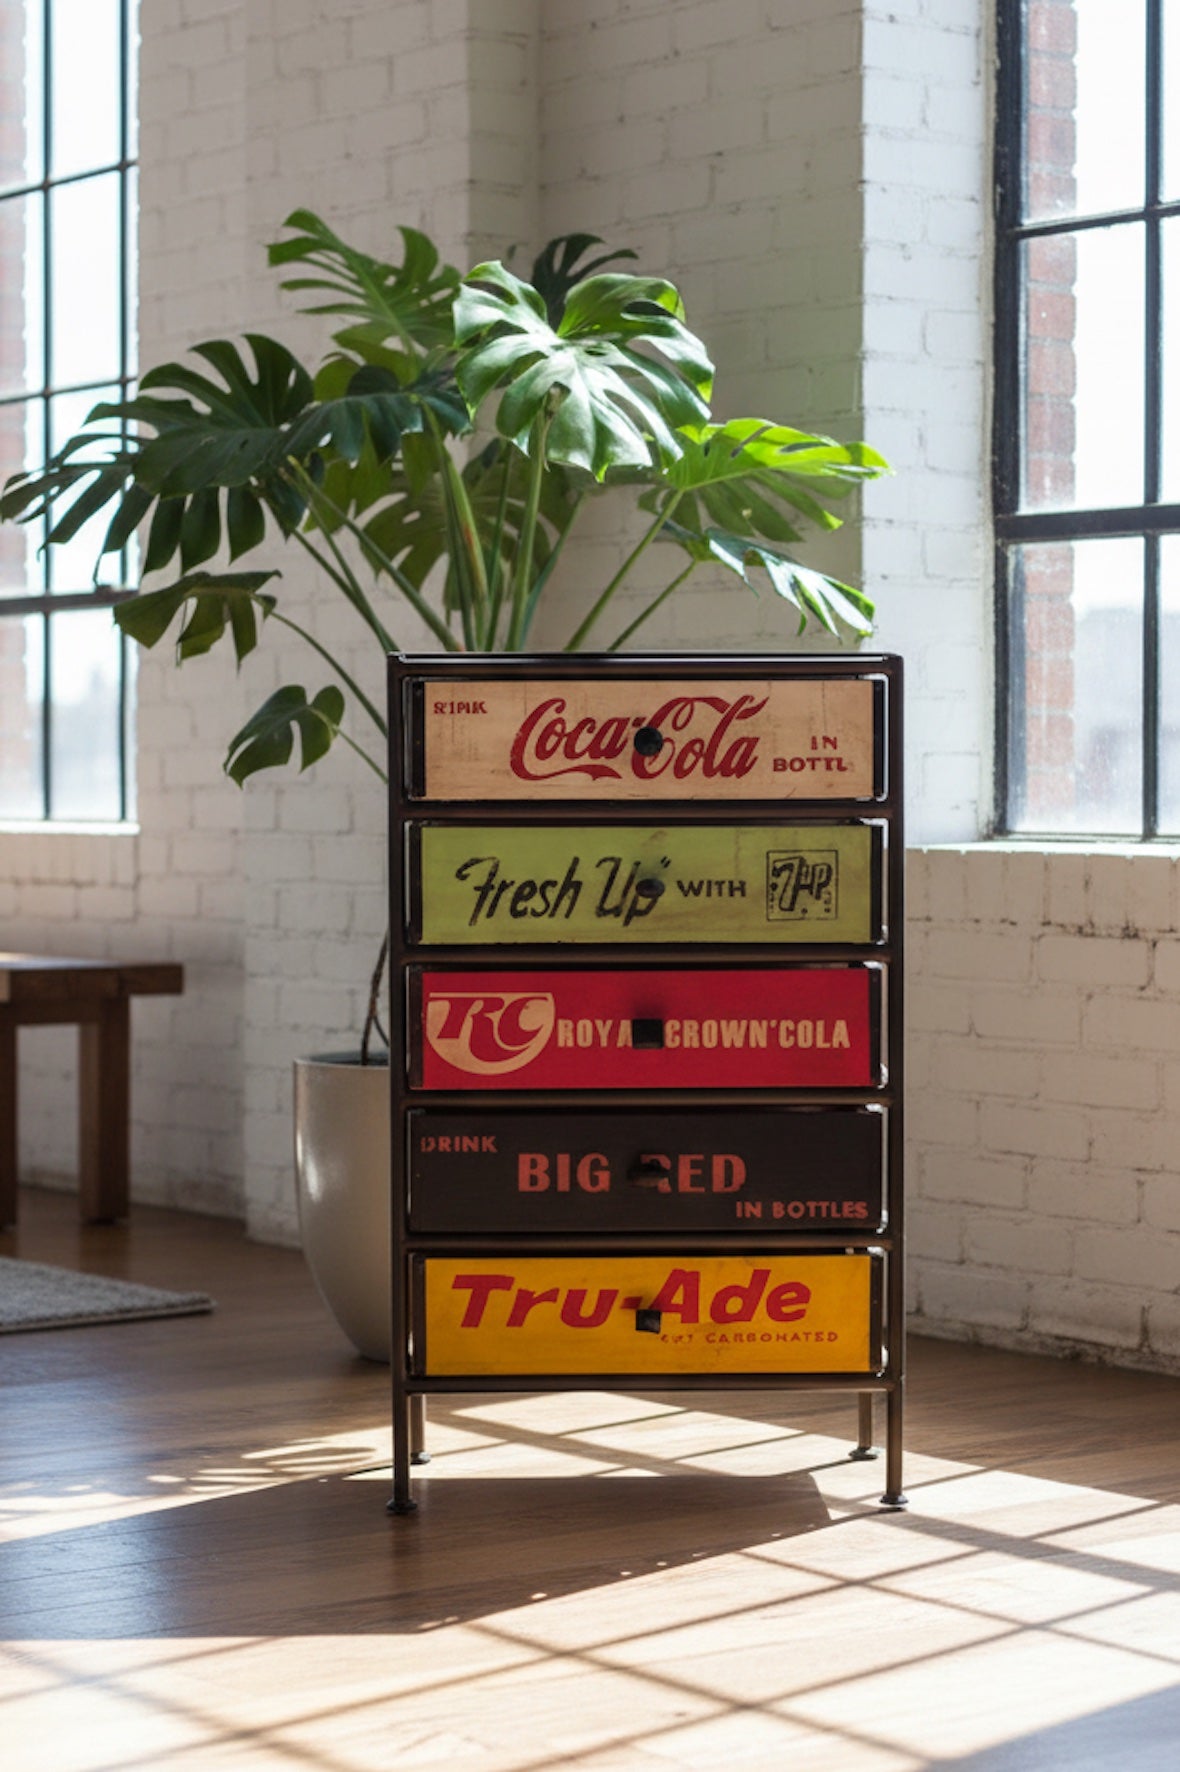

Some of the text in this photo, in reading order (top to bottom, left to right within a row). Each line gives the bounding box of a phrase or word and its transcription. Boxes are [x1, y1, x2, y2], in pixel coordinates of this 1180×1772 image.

[510, 695, 769, 781] Coca-Cola
[811, 735, 838, 751] IN
[455, 856, 583, 927] Fresh
[677, 880, 746, 898] WITH
[428, 996, 549, 1063] RC
[556, 1019, 634, 1048] ROYA
[420, 1135, 498, 1153] DRINK
[518, 1152, 611, 1193] BIG
[735, 1200, 869, 1220] IN BOTTLES
[451, 1268, 812, 1329] Tru-Ade
